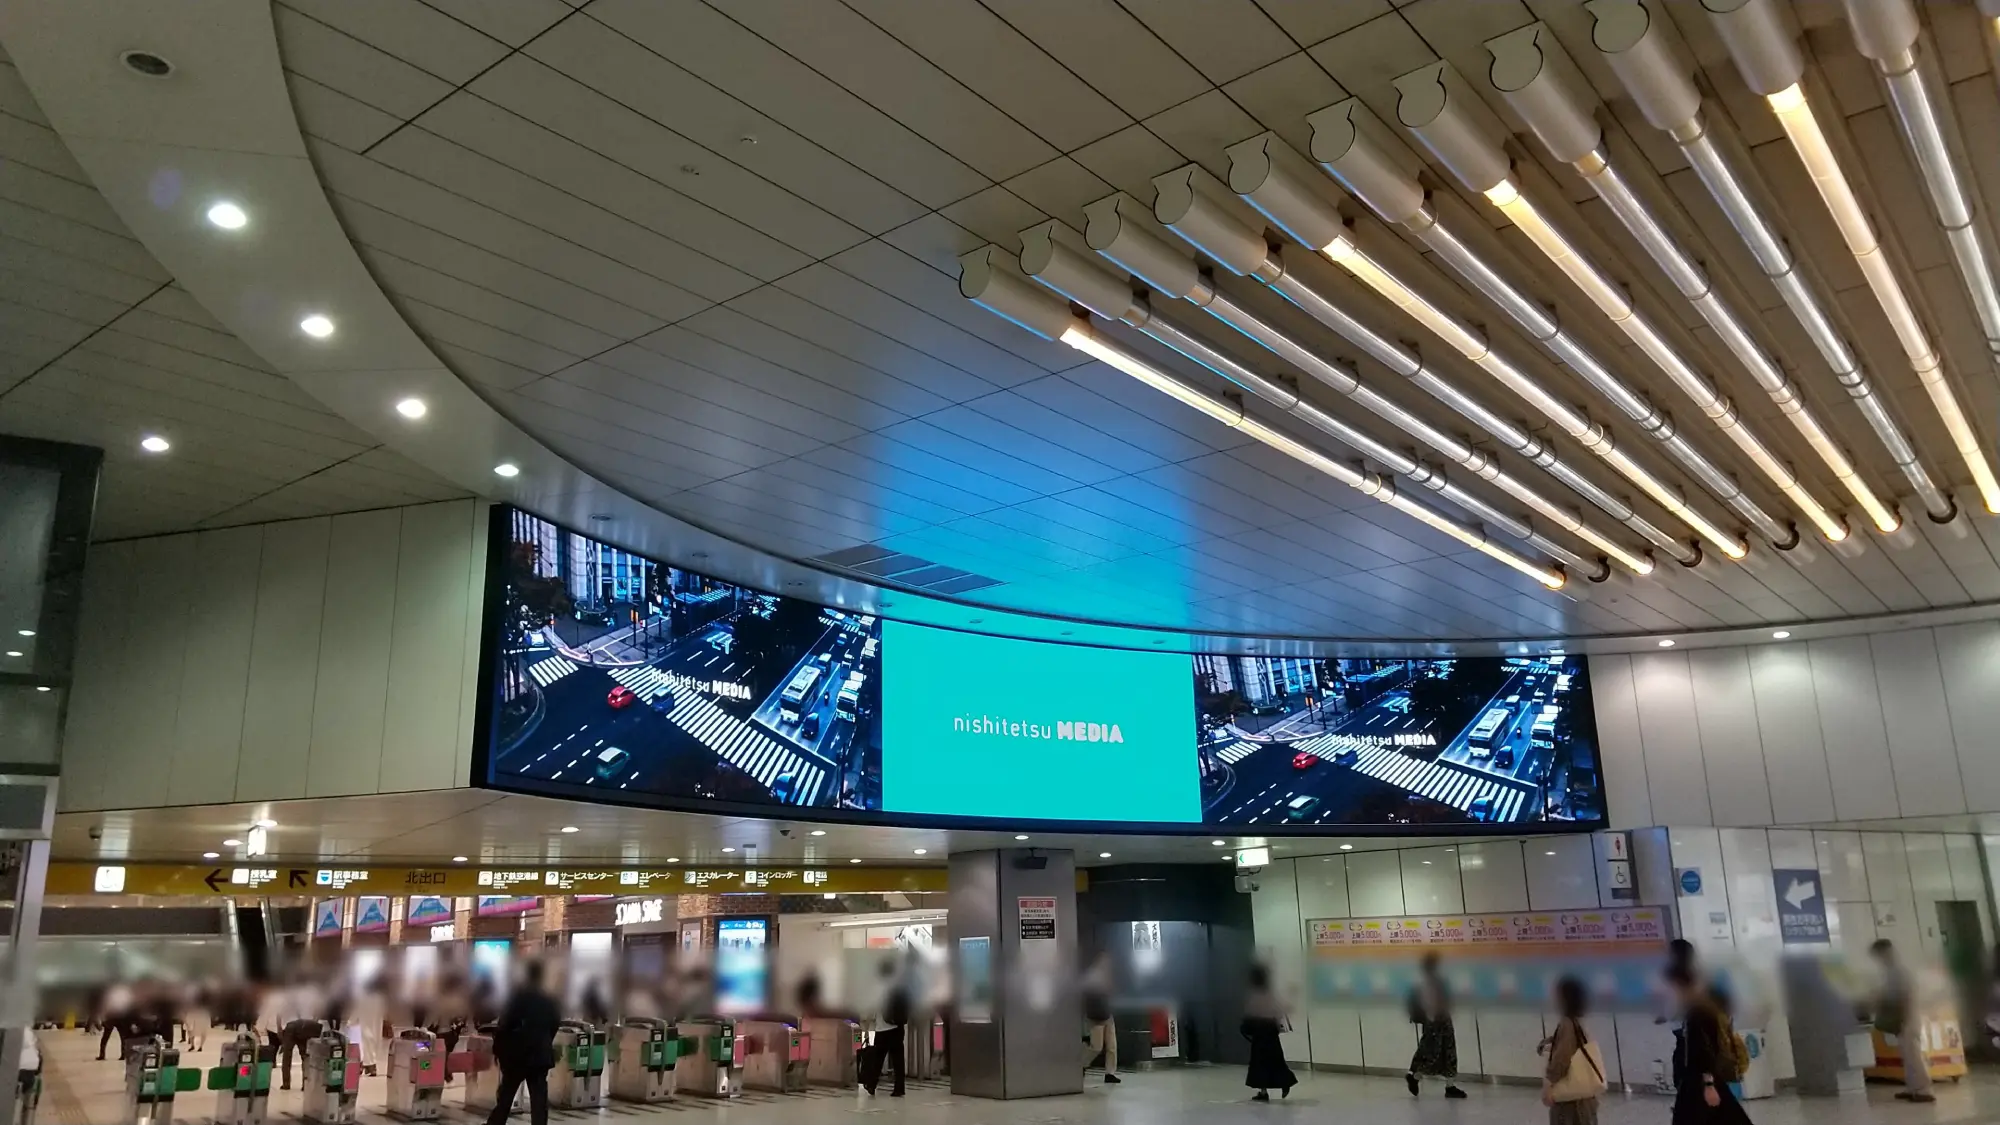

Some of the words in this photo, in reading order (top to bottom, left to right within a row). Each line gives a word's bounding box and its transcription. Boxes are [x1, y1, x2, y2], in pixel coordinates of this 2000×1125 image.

[712, 680, 752, 700] MEDIA
[953, 713, 1051, 739] nishitetsu
[1056, 721, 1124, 743] MEDIA
[1393, 733, 1437, 746] MEDIA
[405, 871, 446, 885] 北出口
[560, 872, 614, 880] サービスセンター
[697, 872, 739, 880] エスカレーター
